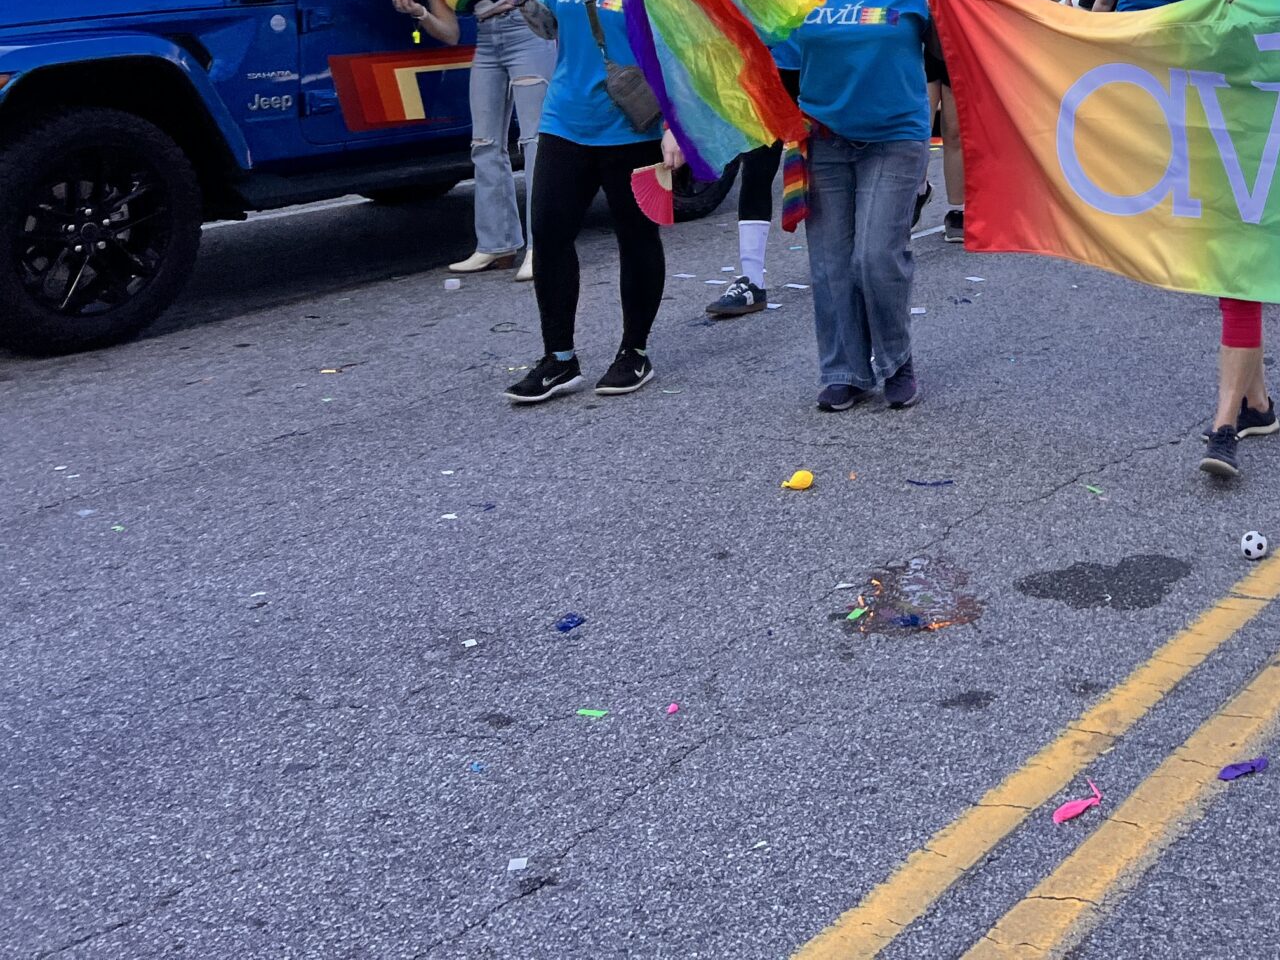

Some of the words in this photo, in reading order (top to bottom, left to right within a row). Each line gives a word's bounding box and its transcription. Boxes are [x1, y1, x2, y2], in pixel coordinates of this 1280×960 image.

[803, 0, 865, 25] avlf
[246, 70, 293, 80] SAHARA
[247, 93, 293, 111] Jeep
